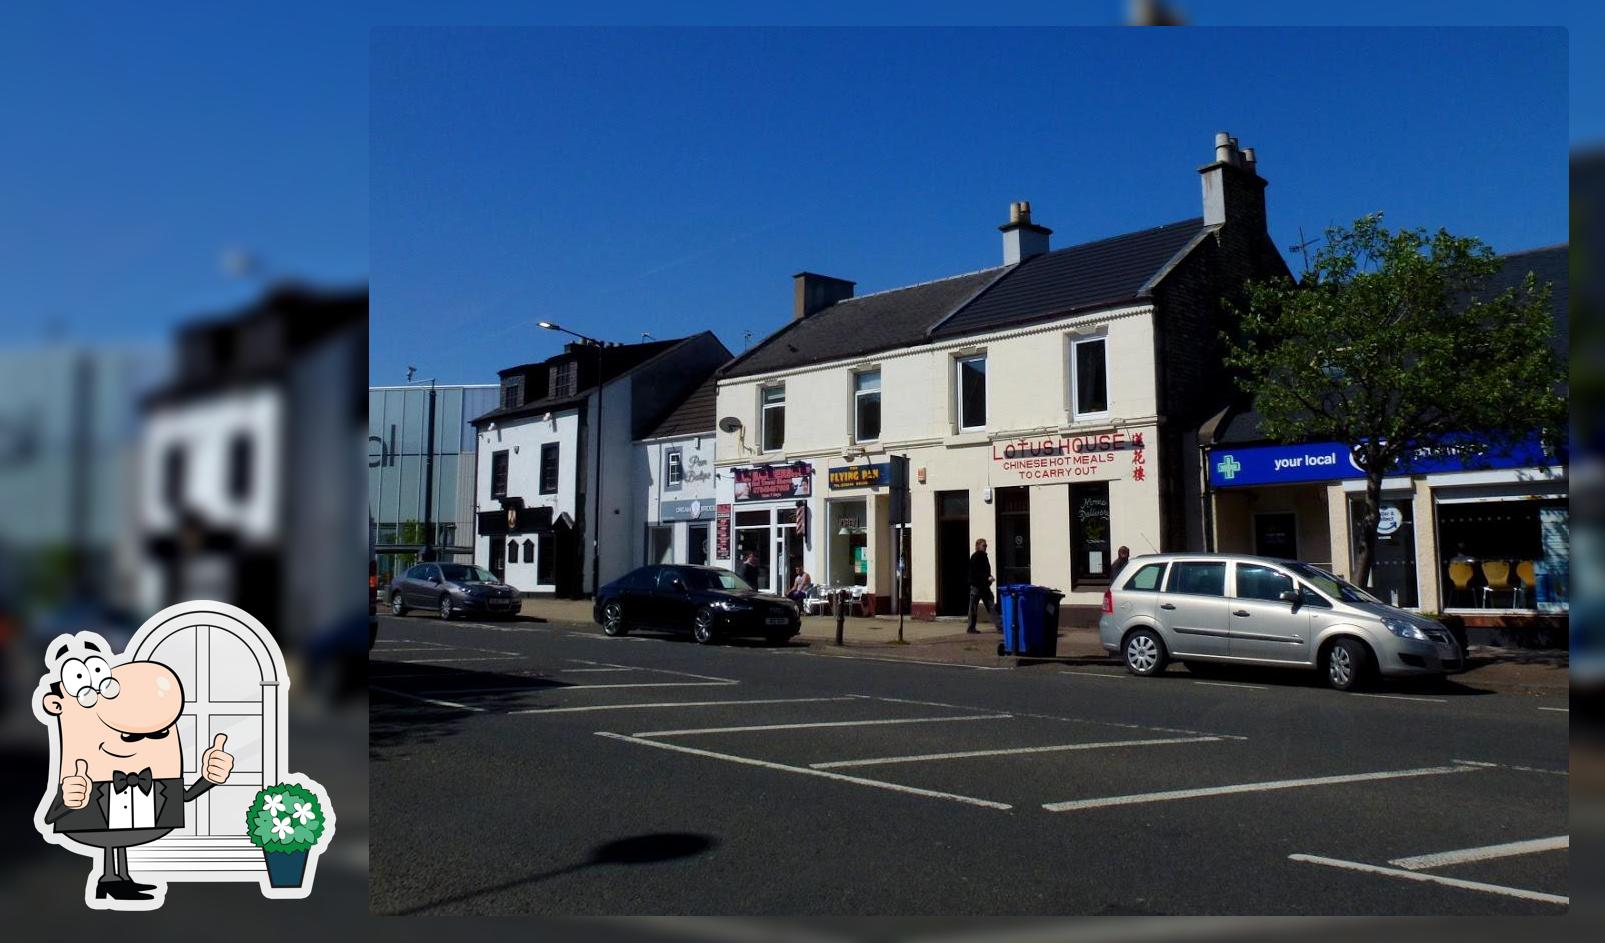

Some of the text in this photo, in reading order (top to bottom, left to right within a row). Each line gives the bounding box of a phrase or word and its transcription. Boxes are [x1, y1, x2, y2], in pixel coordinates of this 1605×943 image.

[993, 433, 1125, 461] LOTUS HOUSE
[1003, 453, 1115, 471] CHINESE HOT MEALS
[1274, 458, 1303, 471] your
[1305, 452, 1336, 466] local
[829, 468, 879, 483] FLYING PAN
[1019, 466, 1098, 480] TO CARRY OUT
